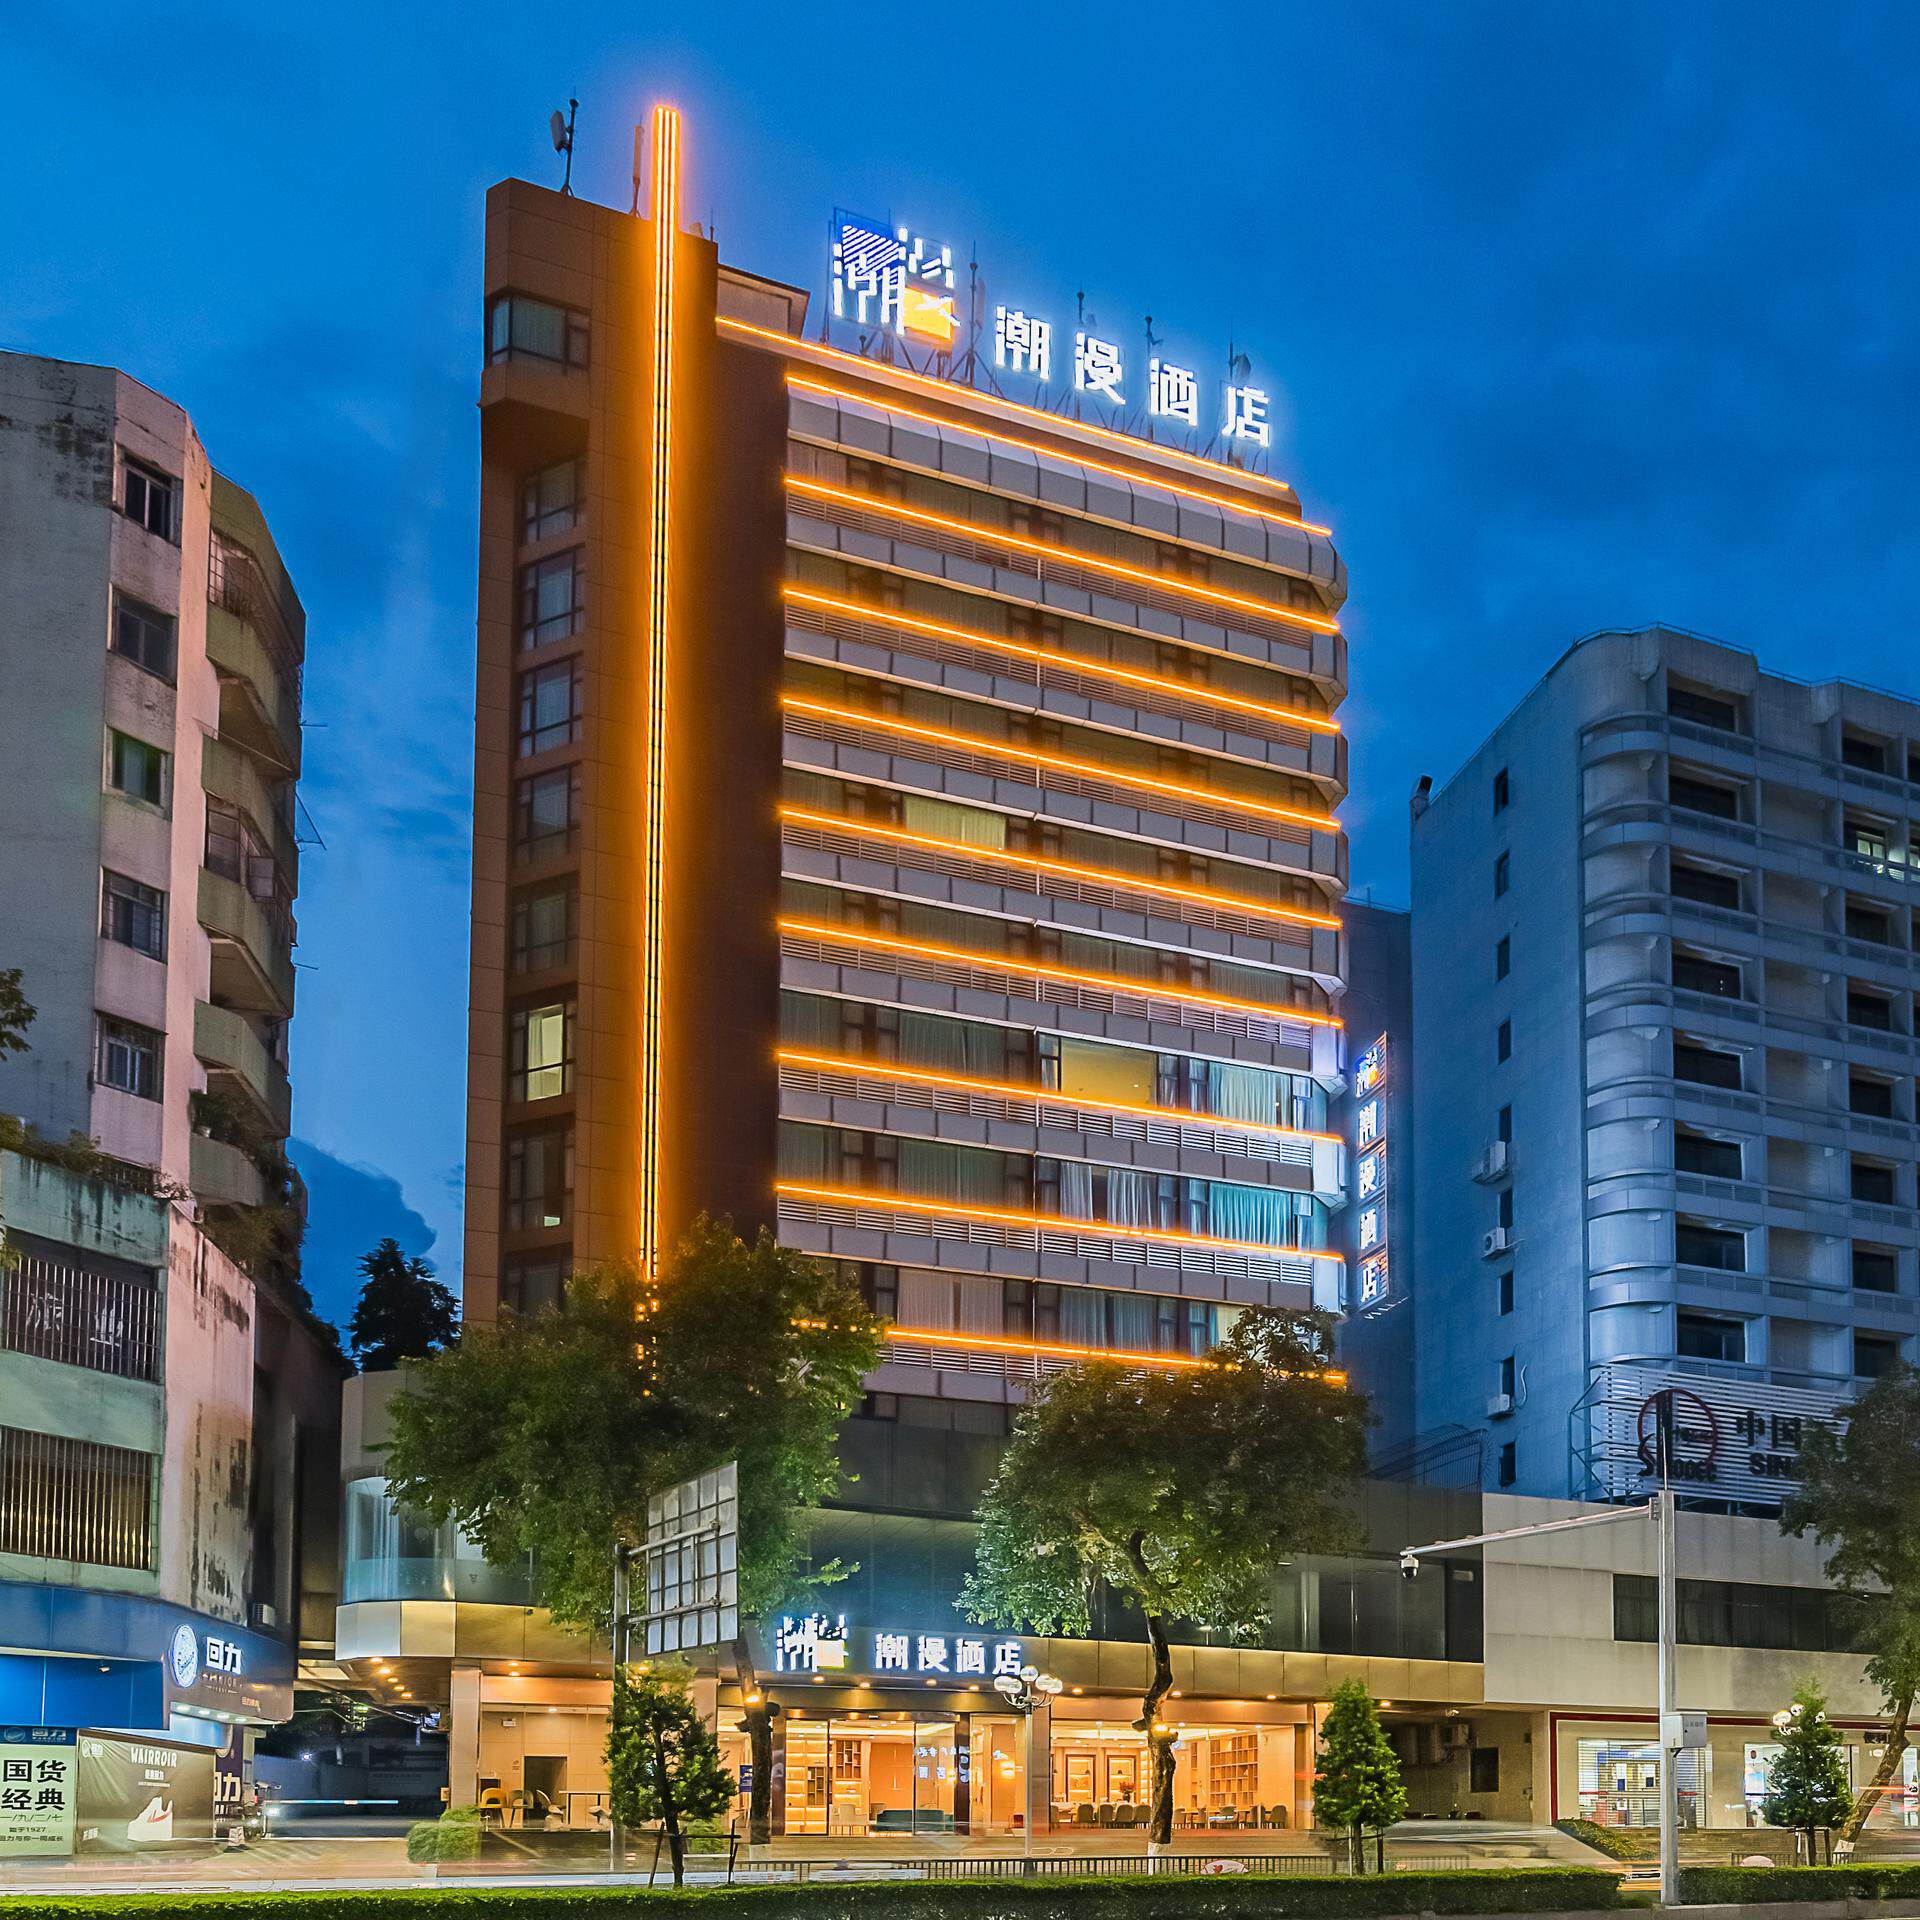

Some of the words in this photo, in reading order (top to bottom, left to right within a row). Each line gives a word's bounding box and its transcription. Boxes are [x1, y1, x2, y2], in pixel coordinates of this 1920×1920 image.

[995, 305, 1270, 448] 潮漫酒店
[1358, 1100, 1378, 1303] 潮漫酒店
[1748, 1452, 1793, 1476] SIN
[206, 1636, 242, 1675] 回力
[874, 1632, 1022, 1676] 潮漫酒店
[3, 1759, 67, 1783] 国货
[1, 1788, 66, 1811] 经典
